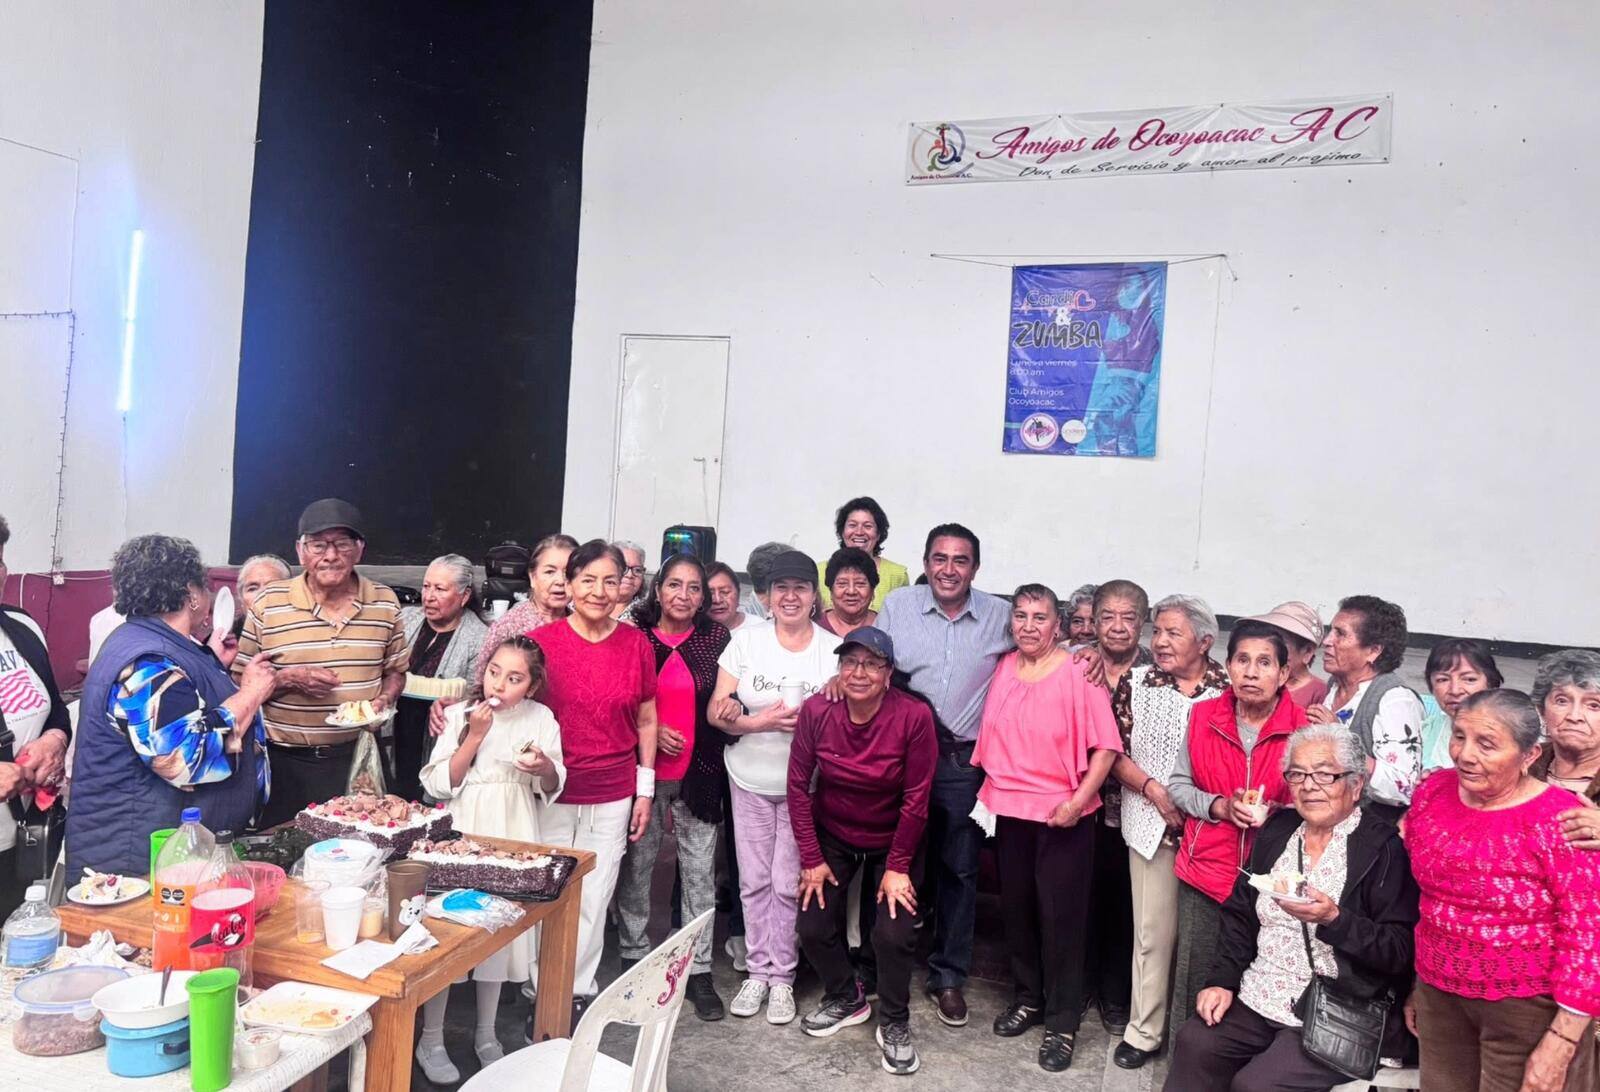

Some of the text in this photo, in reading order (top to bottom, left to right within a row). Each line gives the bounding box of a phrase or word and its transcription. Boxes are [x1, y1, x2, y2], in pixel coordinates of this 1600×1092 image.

[976, 106, 1379, 163] Amigos de Ocoyoacac A C
[1061, 164, 1080, 175] de
[1091, 160, 1168, 173] Servicio
[1173, 161, 1190, 171] y
[1201, 159, 1248, 168] amor
[1257, 152, 1285, 165] al
[1056, 307, 1072, 325] &
[1012, 320, 1103, 349] ZUMBA
[1008, 398, 1055, 407] Ocoyoacac
[1009, 387, 1064, 398] Club Amigos
